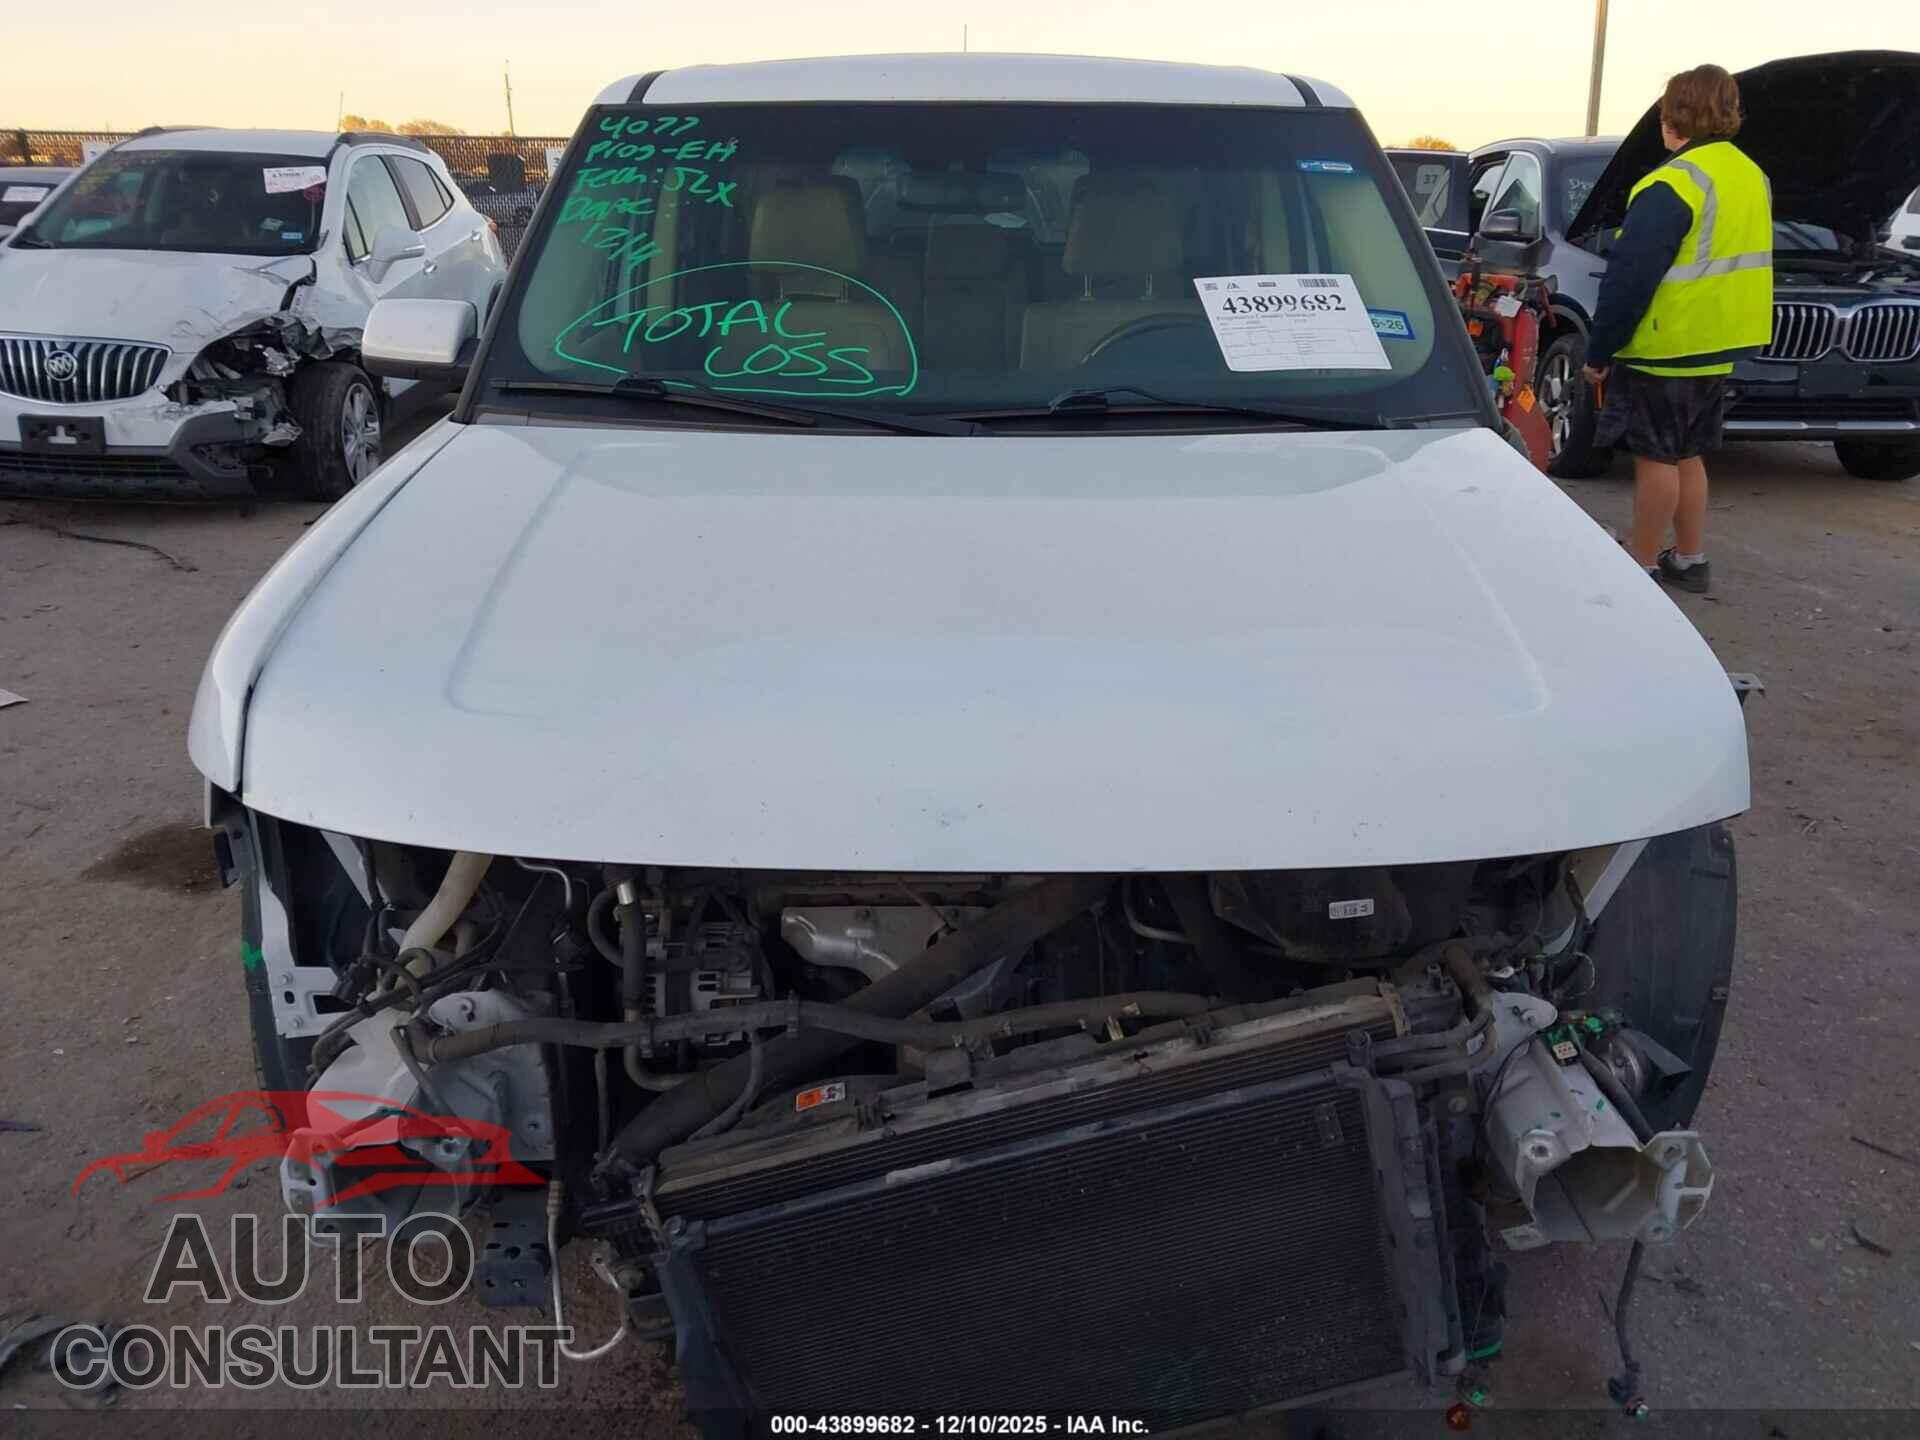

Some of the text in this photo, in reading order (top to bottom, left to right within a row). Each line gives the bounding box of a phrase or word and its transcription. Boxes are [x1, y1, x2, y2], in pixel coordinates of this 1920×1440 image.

[600, 116, 700, 140] 4077
[1221, 293, 1347, 314] 43899682
[592, 299, 828, 353] TOTAL
[704, 343, 875, 384] LOSS
